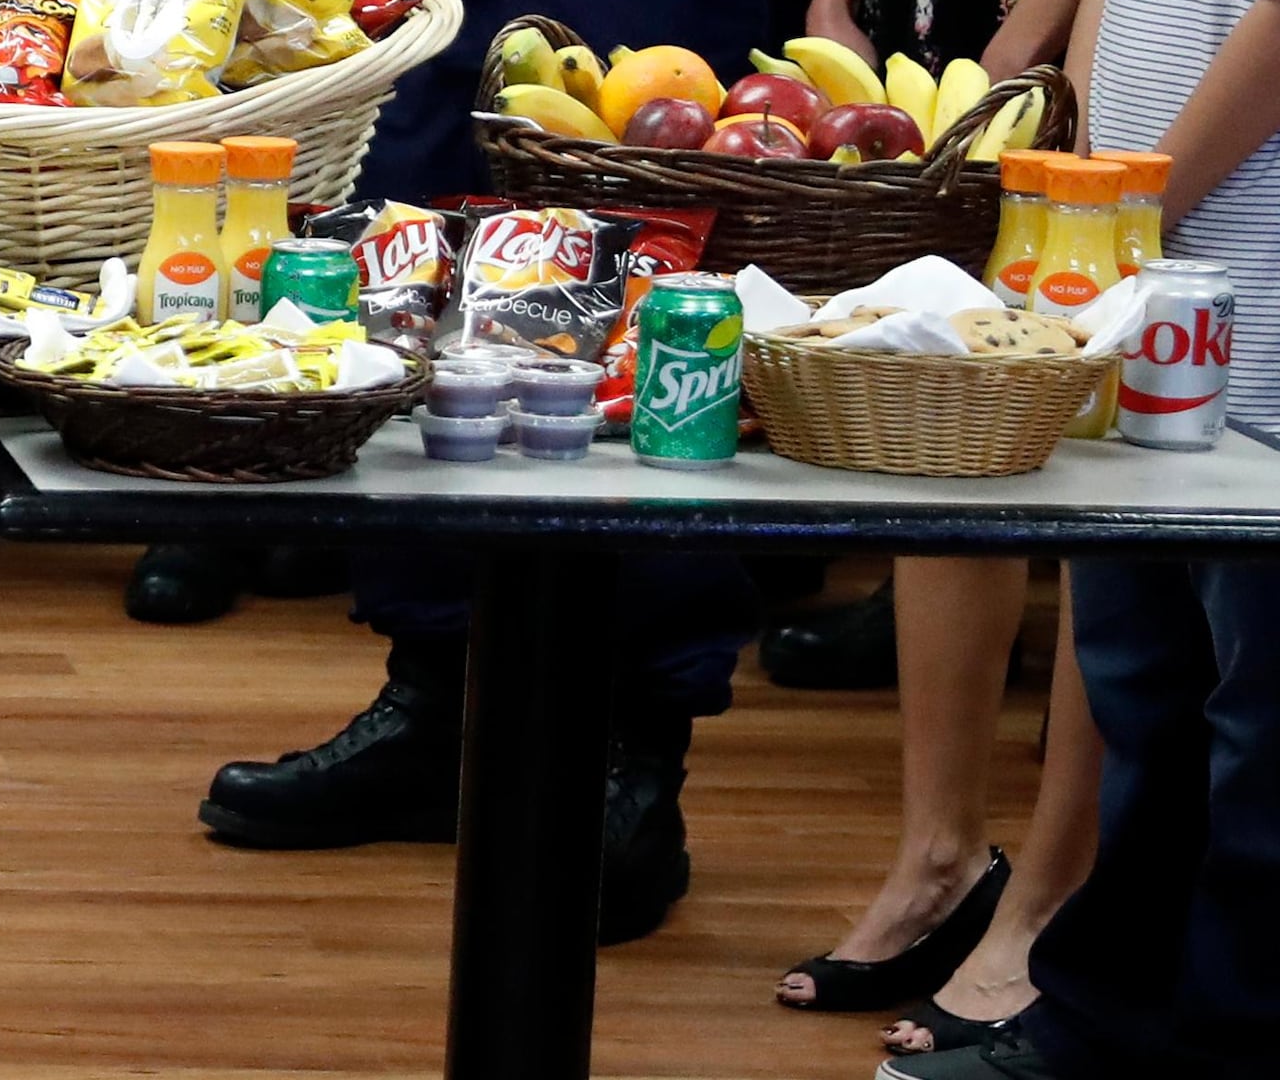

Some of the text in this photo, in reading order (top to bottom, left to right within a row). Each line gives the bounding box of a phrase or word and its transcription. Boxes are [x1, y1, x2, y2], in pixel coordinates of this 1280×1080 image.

[169, 265, 206, 274] NO PULP
[245, 261, 260, 270] NO
[1010, 273, 1025, 283] NO
[1049, 285, 1089, 295] NO PULP
[158, 292, 215, 310] Tropicana
[1121, 307, 1233, 367] ok
